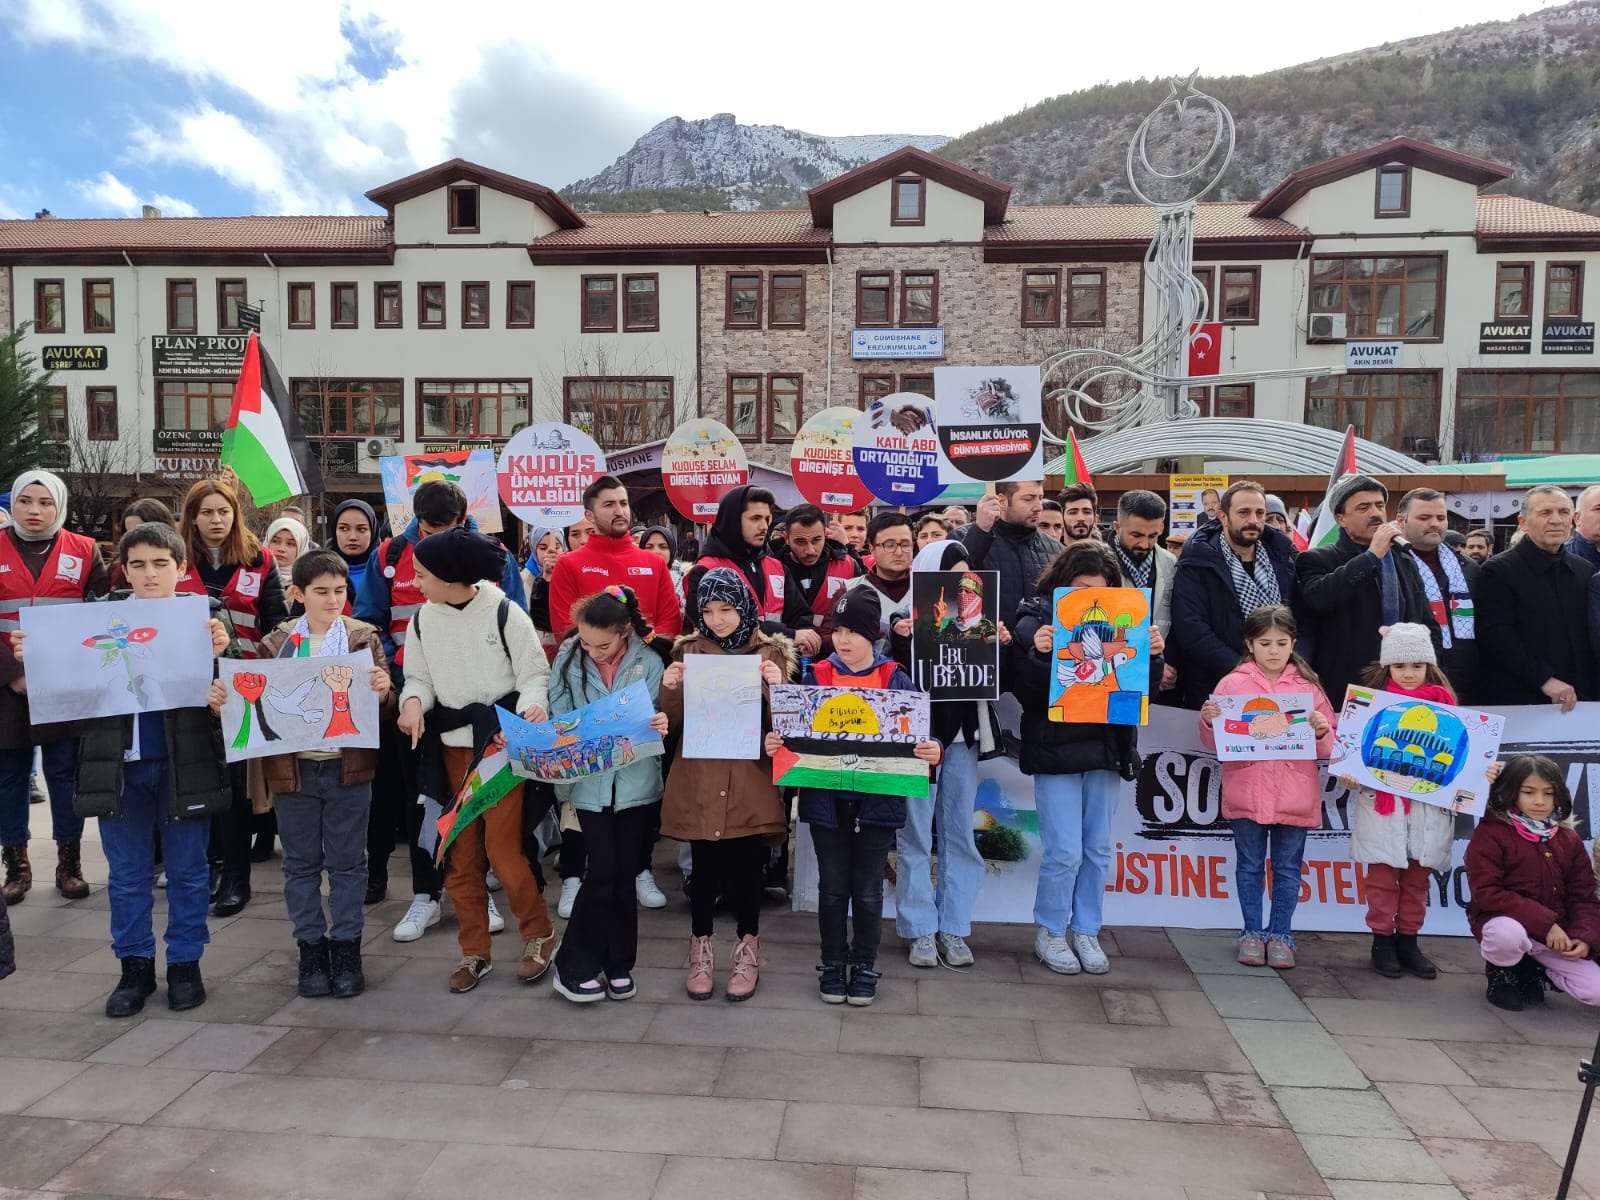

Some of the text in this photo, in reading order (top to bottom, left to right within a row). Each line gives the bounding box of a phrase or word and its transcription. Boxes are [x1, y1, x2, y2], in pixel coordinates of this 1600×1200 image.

[1483, 326, 1530, 336] AVUKAT
[1545, 326, 1593, 336] AVUKAT
[45, 347, 104, 359] AVUKAT
[1350, 346, 1399, 357] AVUKAT
[950, 427, 1029, 441] İNSANLIK ÖLÜYOR
[876, 435, 937, 451] KATİL ABD
[953, 442, 1029, 455] DÜNYA SEYREDİYOR
[508, 451, 596, 473] KUDÜS
[707, 459, 737, 470] SELAM
[799, 459, 844, 477] DİRENİŞE
[885, 464, 924, 479] DEFOL
[511, 472, 593, 488] ÜMMETİN
[669, 472, 741, 487] DİRENİŞE DEVAM
[939, 643, 967, 666] EBU
[918, 659, 995, 693] UBEYDE
